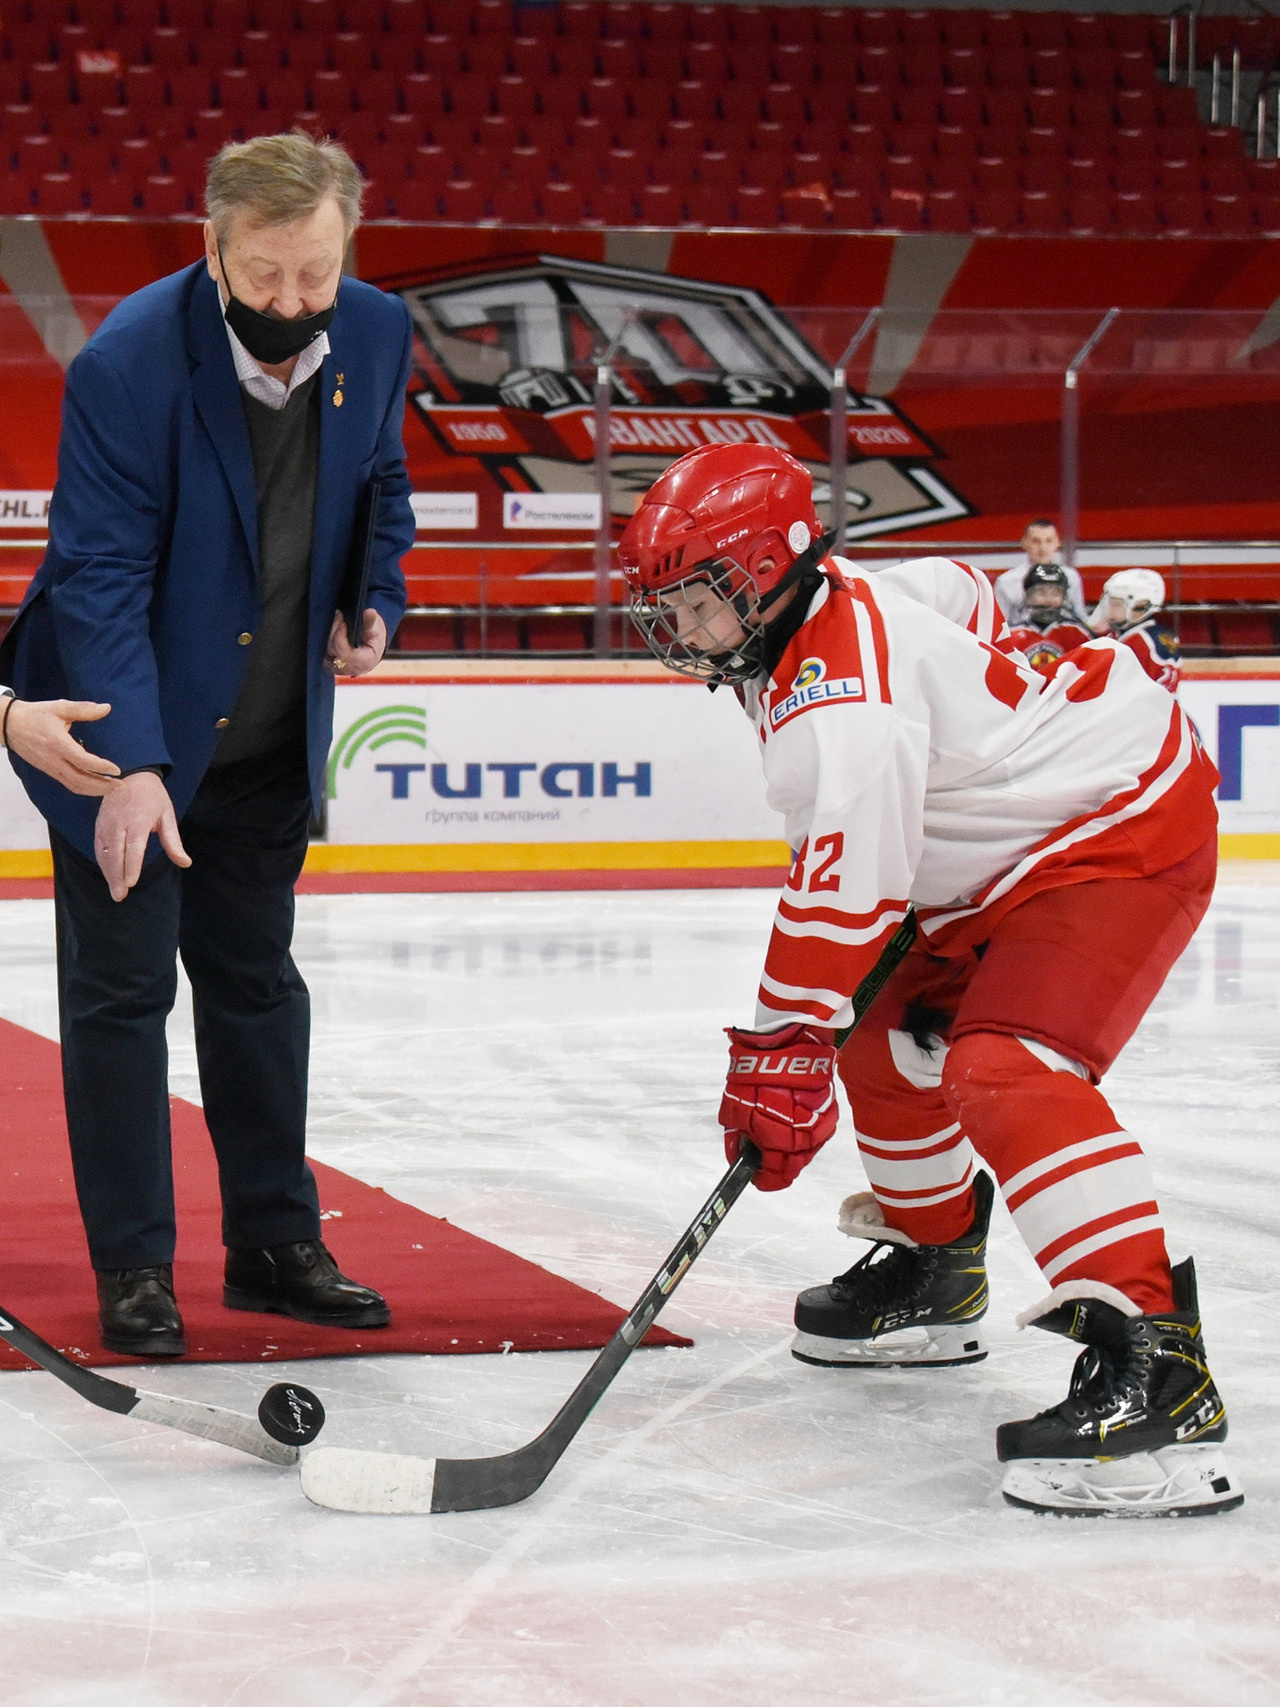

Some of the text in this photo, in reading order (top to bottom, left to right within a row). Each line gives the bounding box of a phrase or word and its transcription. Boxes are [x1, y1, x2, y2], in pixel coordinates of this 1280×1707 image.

[448, 421, 508, 443] 1950
[849, 425, 912, 445] 2020
[524, 509, 594, 522] Ростелеком
[717, 528, 749, 549] CCM
[773, 680, 860, 722] ERIELL
[424, 806, 561, 824] группа компаний
